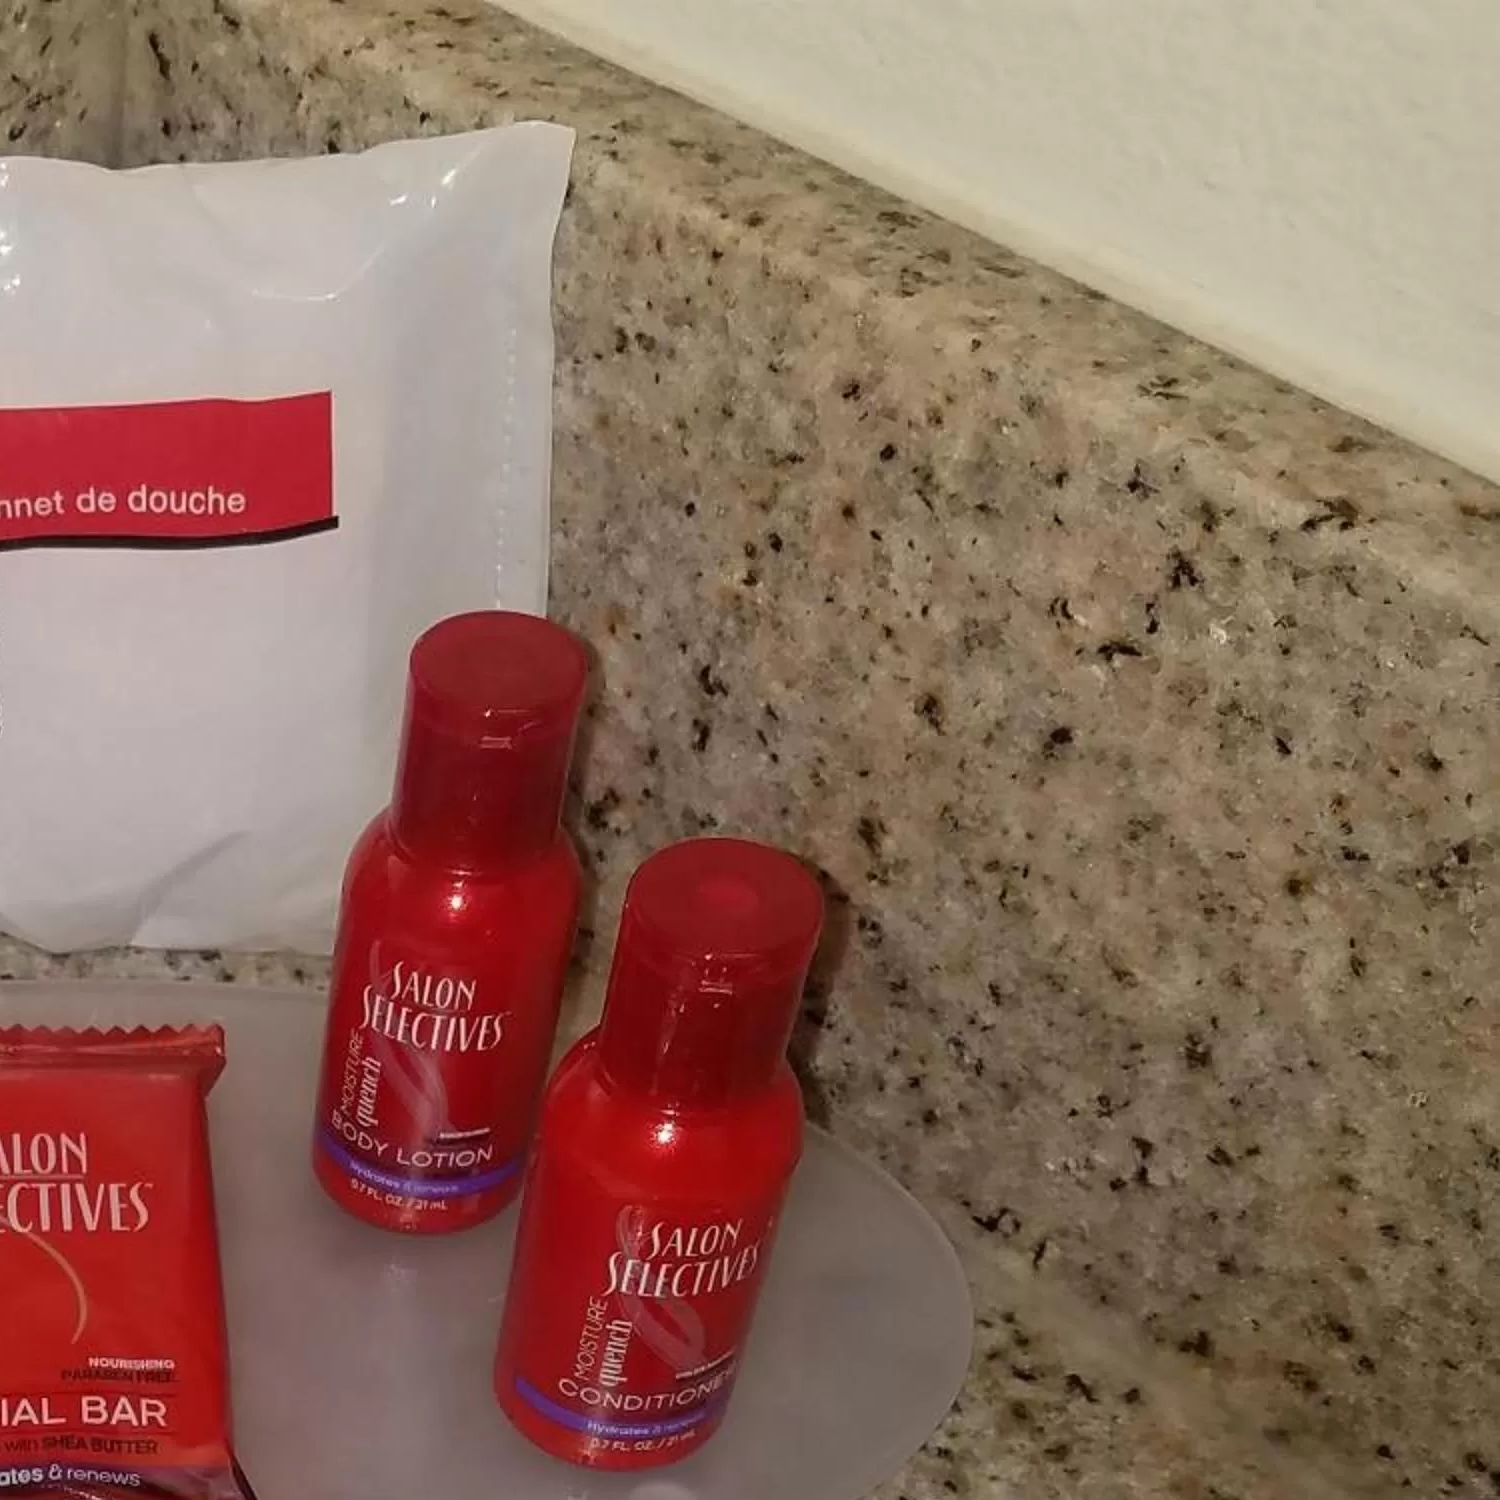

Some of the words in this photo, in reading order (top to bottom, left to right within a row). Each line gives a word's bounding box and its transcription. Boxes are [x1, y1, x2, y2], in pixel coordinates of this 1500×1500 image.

[76, 486, 117, 513] de
[128, 484, 247, 516] douche
[389, 960, 477, 1011] SALON
[358, 984, 503, 1053] SELECTIVES
[339, 1027, 365, 1118] MOISTURE
[356, 1056, 382, 1128] quench
[331, 1109, 389, 1156] BODY
[396, 1145, 494, 1169] LOTION
[646, 1217, 744, 1261] SALON
[601, 1241, 762, 1298] SELECTIVES
[88, 1357, 175, 1371] NOURISHING
[573, 1296, 608, 1381] MOISTURE
[598, 1318, 633, 1388] quench
[80, 1395, 168, 1427] BAR
[41, 1435, 88, 1452] SHEA
[90, 1439, 158, 1454] BUTTER
[48, 1463, 63, 1481] &
[66, 1467, 142, 1487] renews
